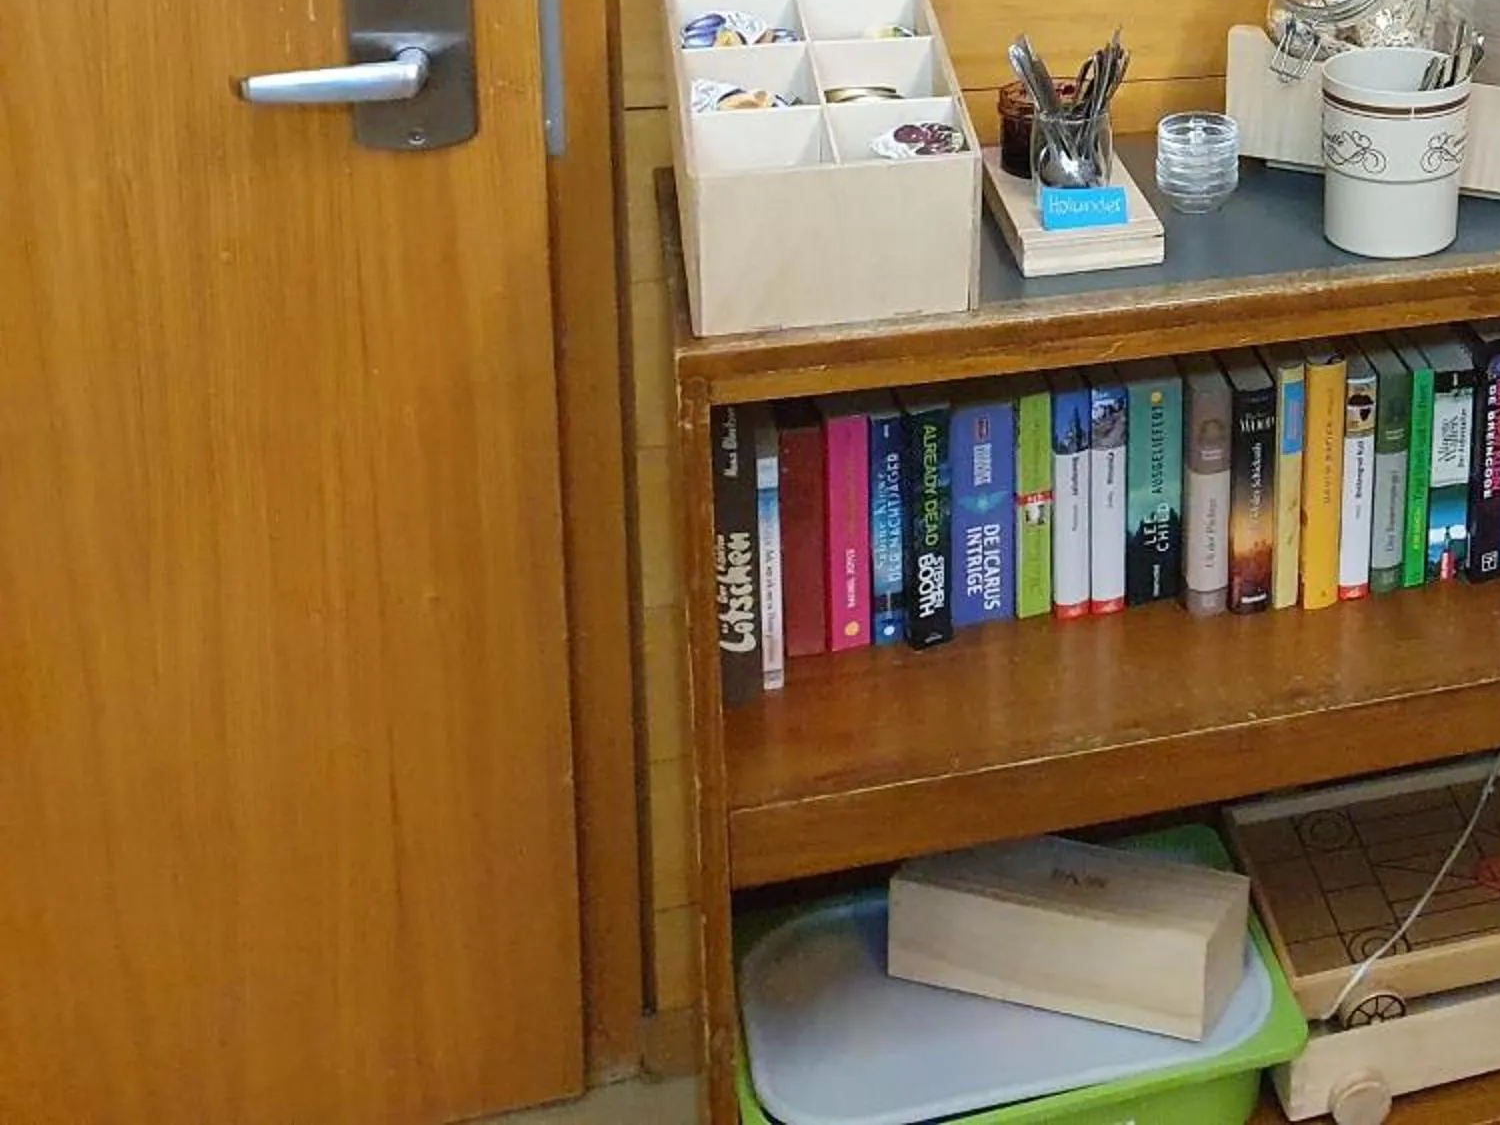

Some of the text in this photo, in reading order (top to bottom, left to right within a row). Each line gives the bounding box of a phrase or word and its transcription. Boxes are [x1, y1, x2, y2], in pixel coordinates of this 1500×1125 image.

[923, 425, 939, 546] ALREADY DEAD
[1144, 511, 1157, 546] LEE
[1156, 502, 1171, 552] CHILD
[918, 552, 936, 618] BOOTH
[966, 526, 983, 597] INTRIGE
[984, 524, 1000, 611] DE ICARUS
